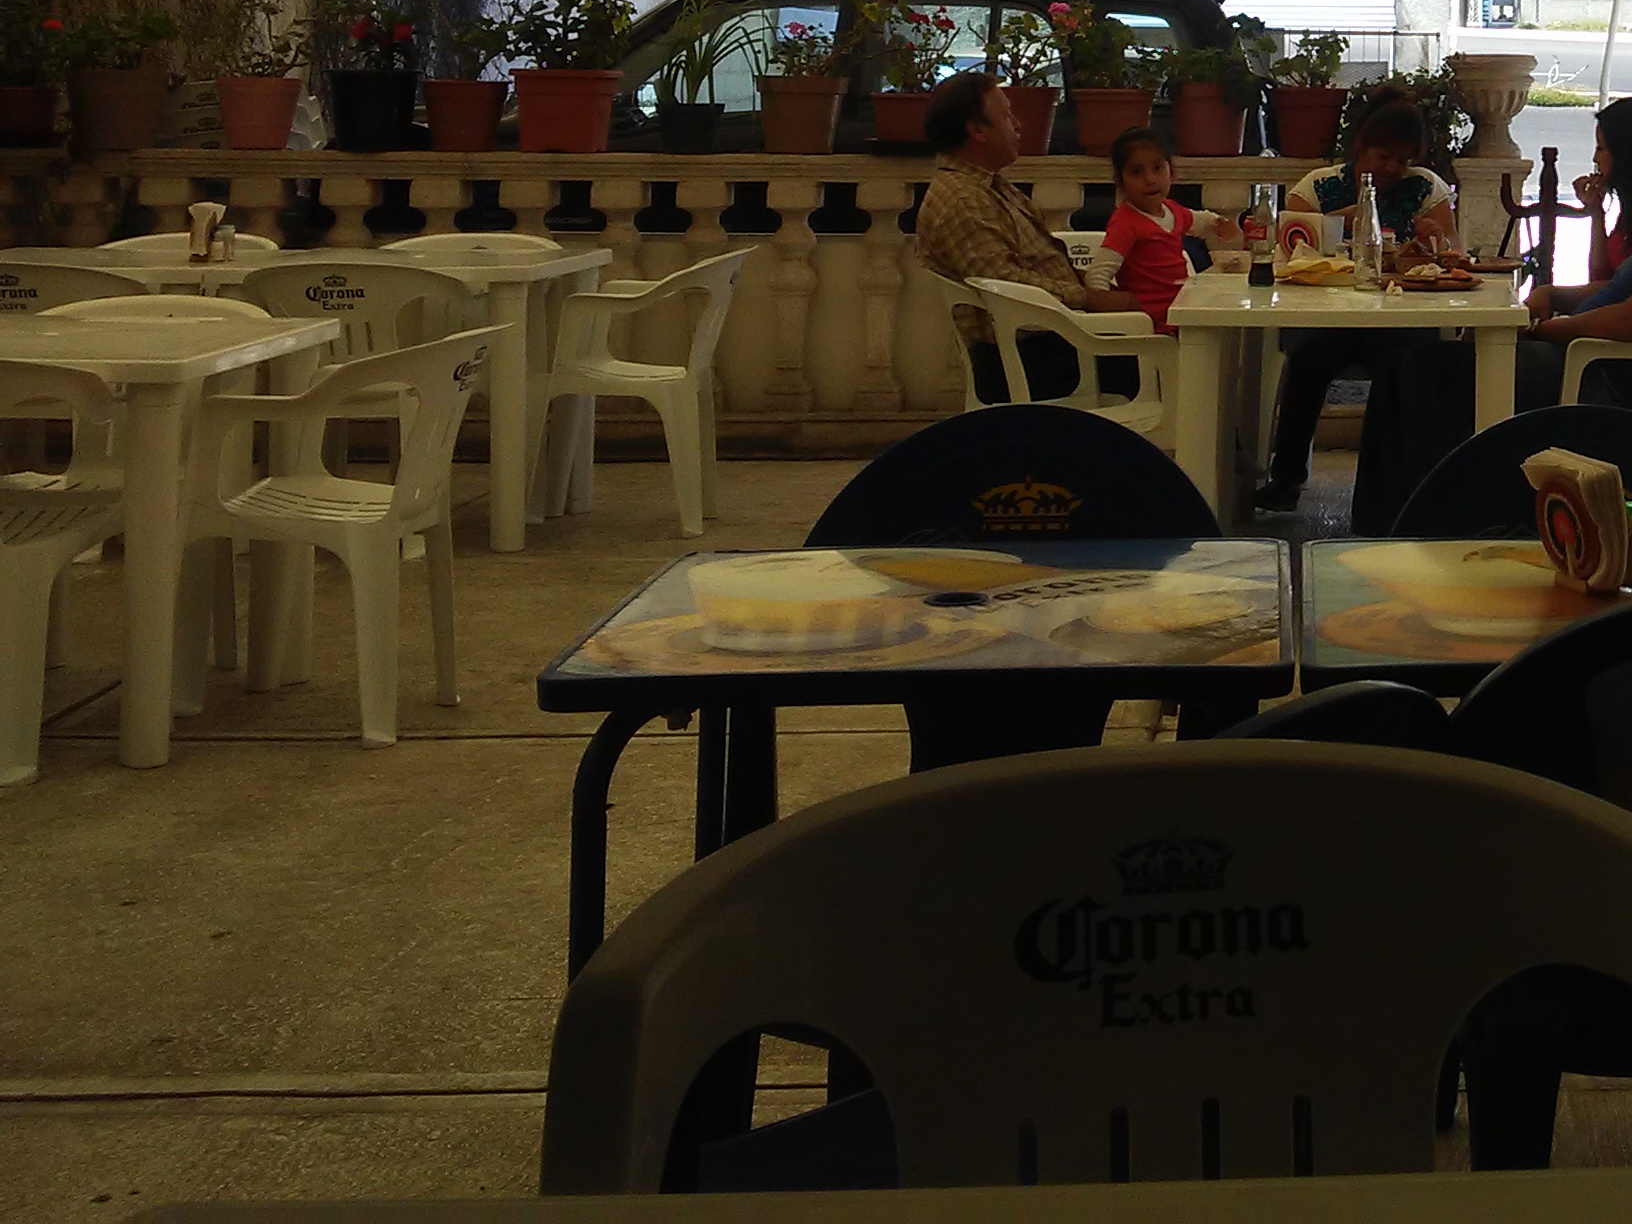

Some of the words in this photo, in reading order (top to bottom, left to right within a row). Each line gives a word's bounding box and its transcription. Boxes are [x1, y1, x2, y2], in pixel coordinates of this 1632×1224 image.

[0, 288, 39, 299] rona
[305, 285, 366, 301] Corona
[1013, 895, 1311, 991] Corona
[1100, 971, 1256, 1027] Extra
